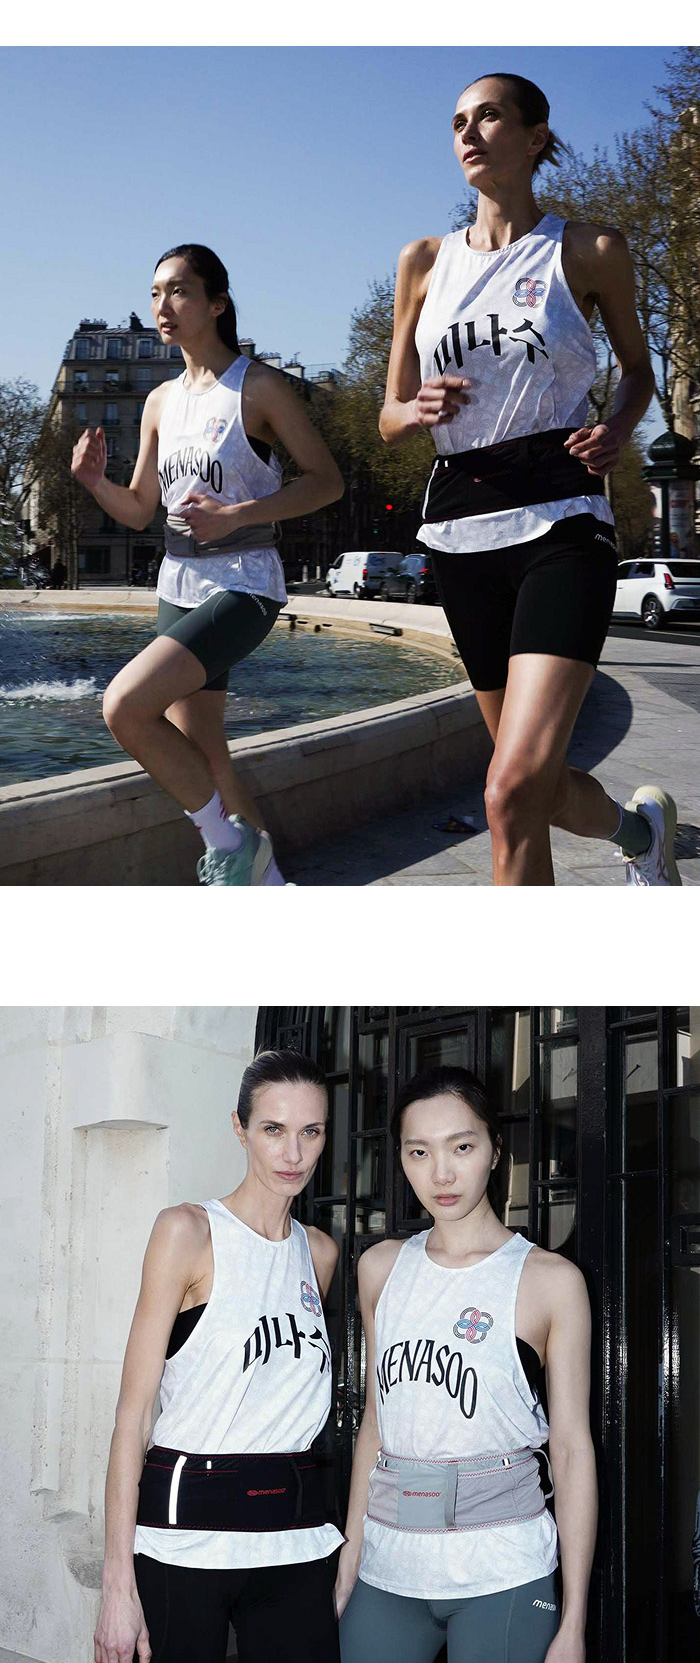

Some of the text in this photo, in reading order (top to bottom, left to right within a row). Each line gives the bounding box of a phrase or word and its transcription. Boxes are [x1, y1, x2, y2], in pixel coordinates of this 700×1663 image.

[434, 314, 549, 377] 미나수
[158, 446, 223, 501] MENASOO
[243, 1313, 330, 1374] 미나수
[377, 1339, 478, 1420] MENASOO
